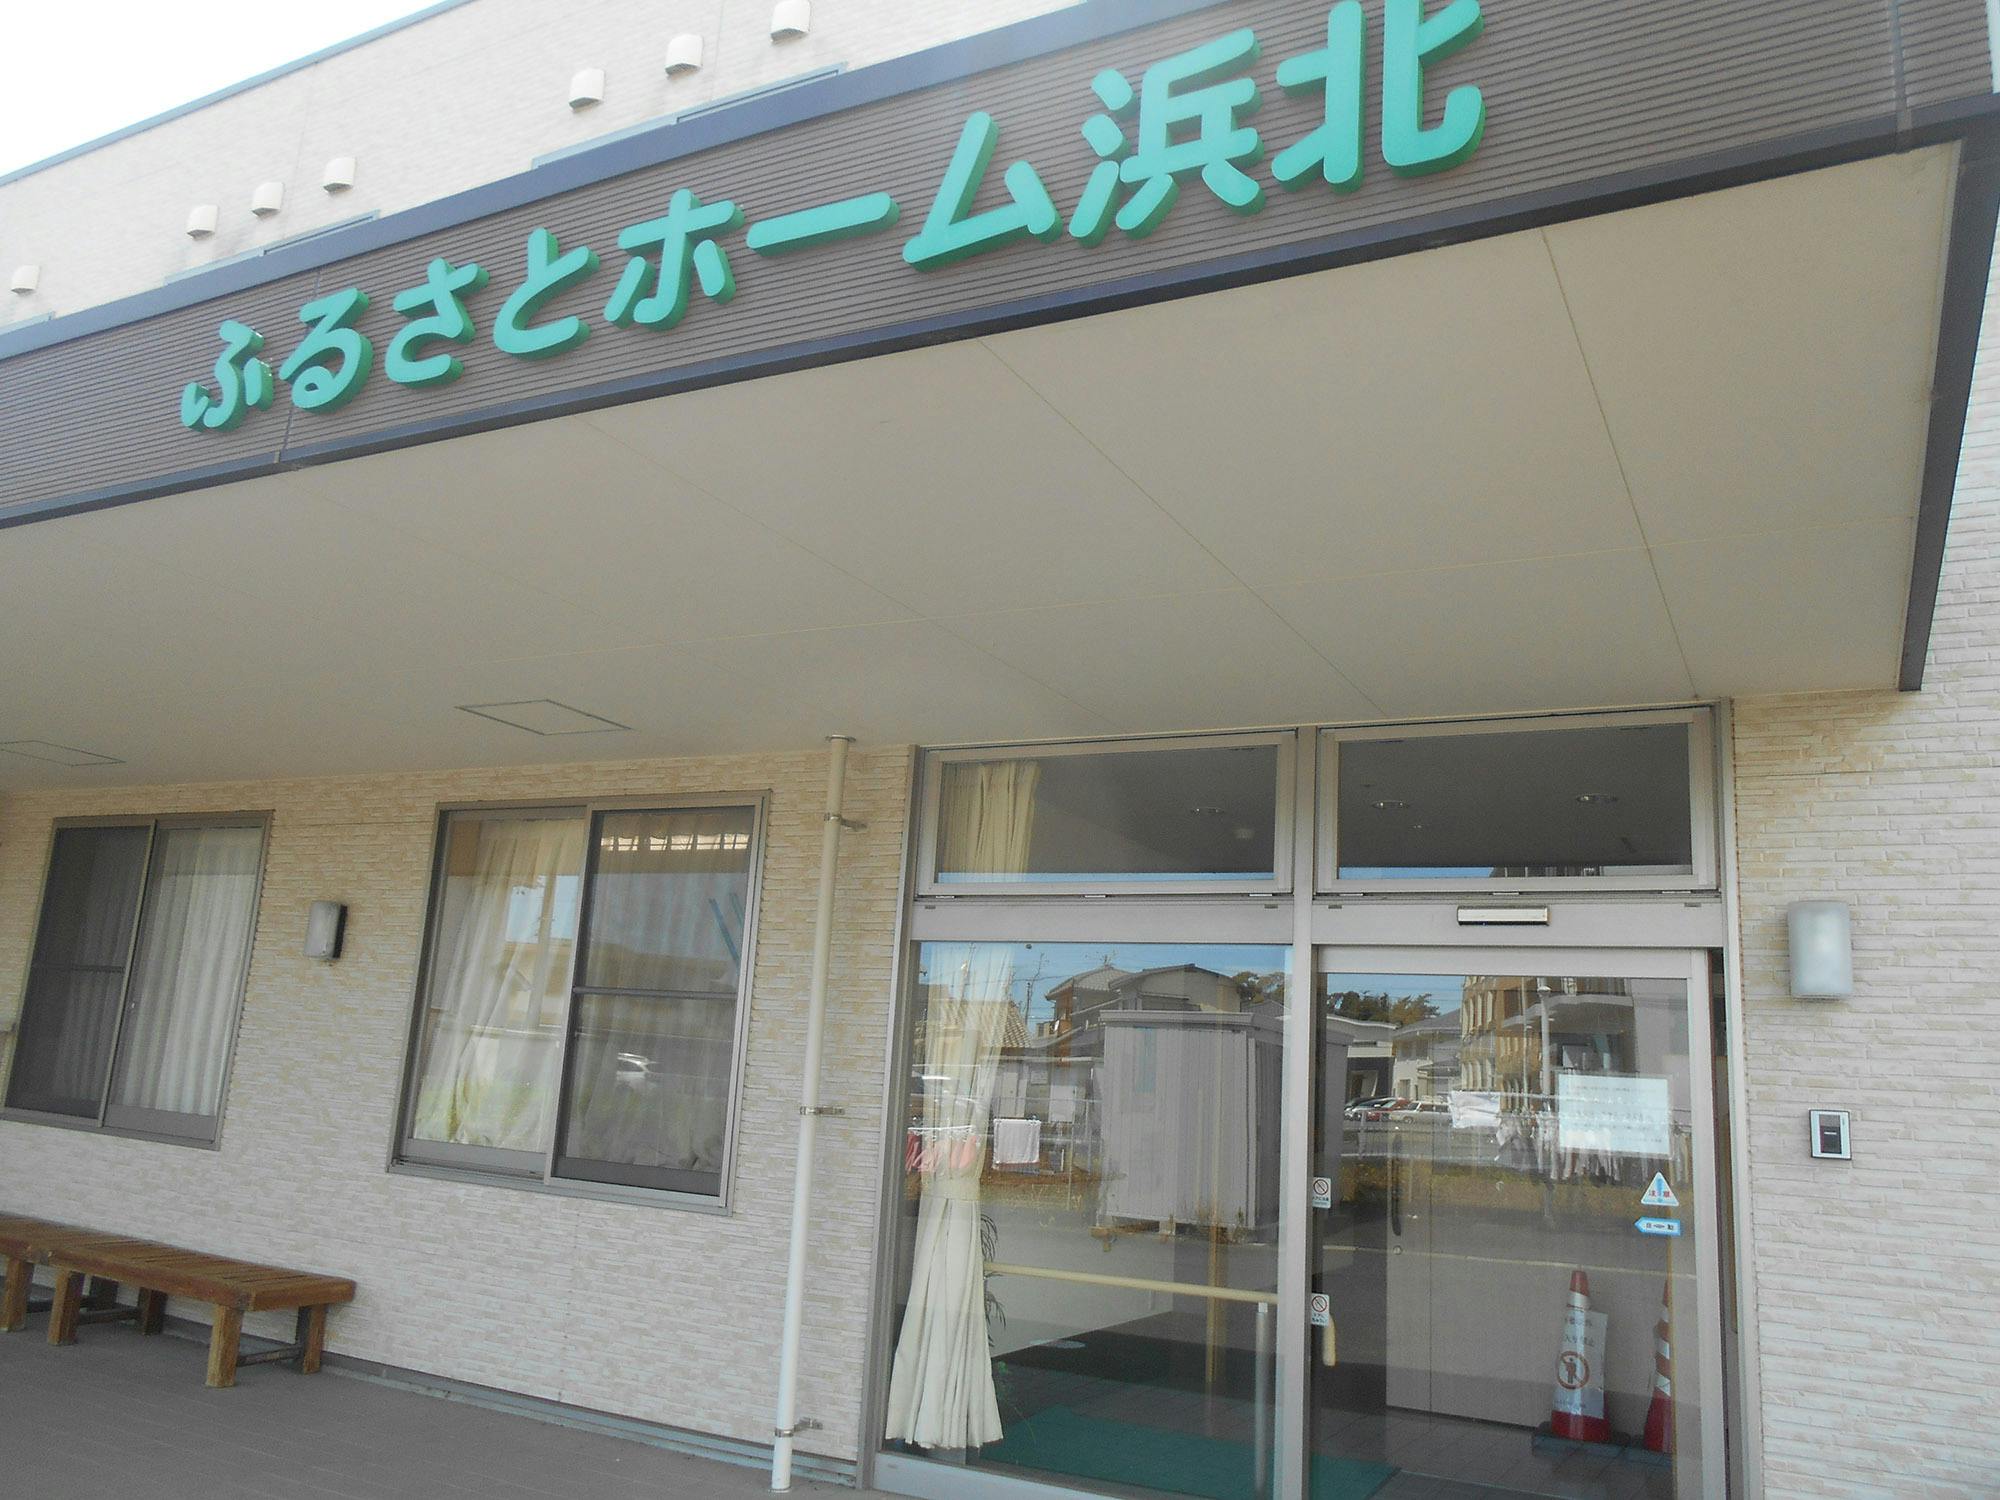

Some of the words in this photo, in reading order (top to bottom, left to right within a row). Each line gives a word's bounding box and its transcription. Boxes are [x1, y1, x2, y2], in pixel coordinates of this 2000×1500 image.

[180, 0, 1486, 432] ふるさとホーム浜北
